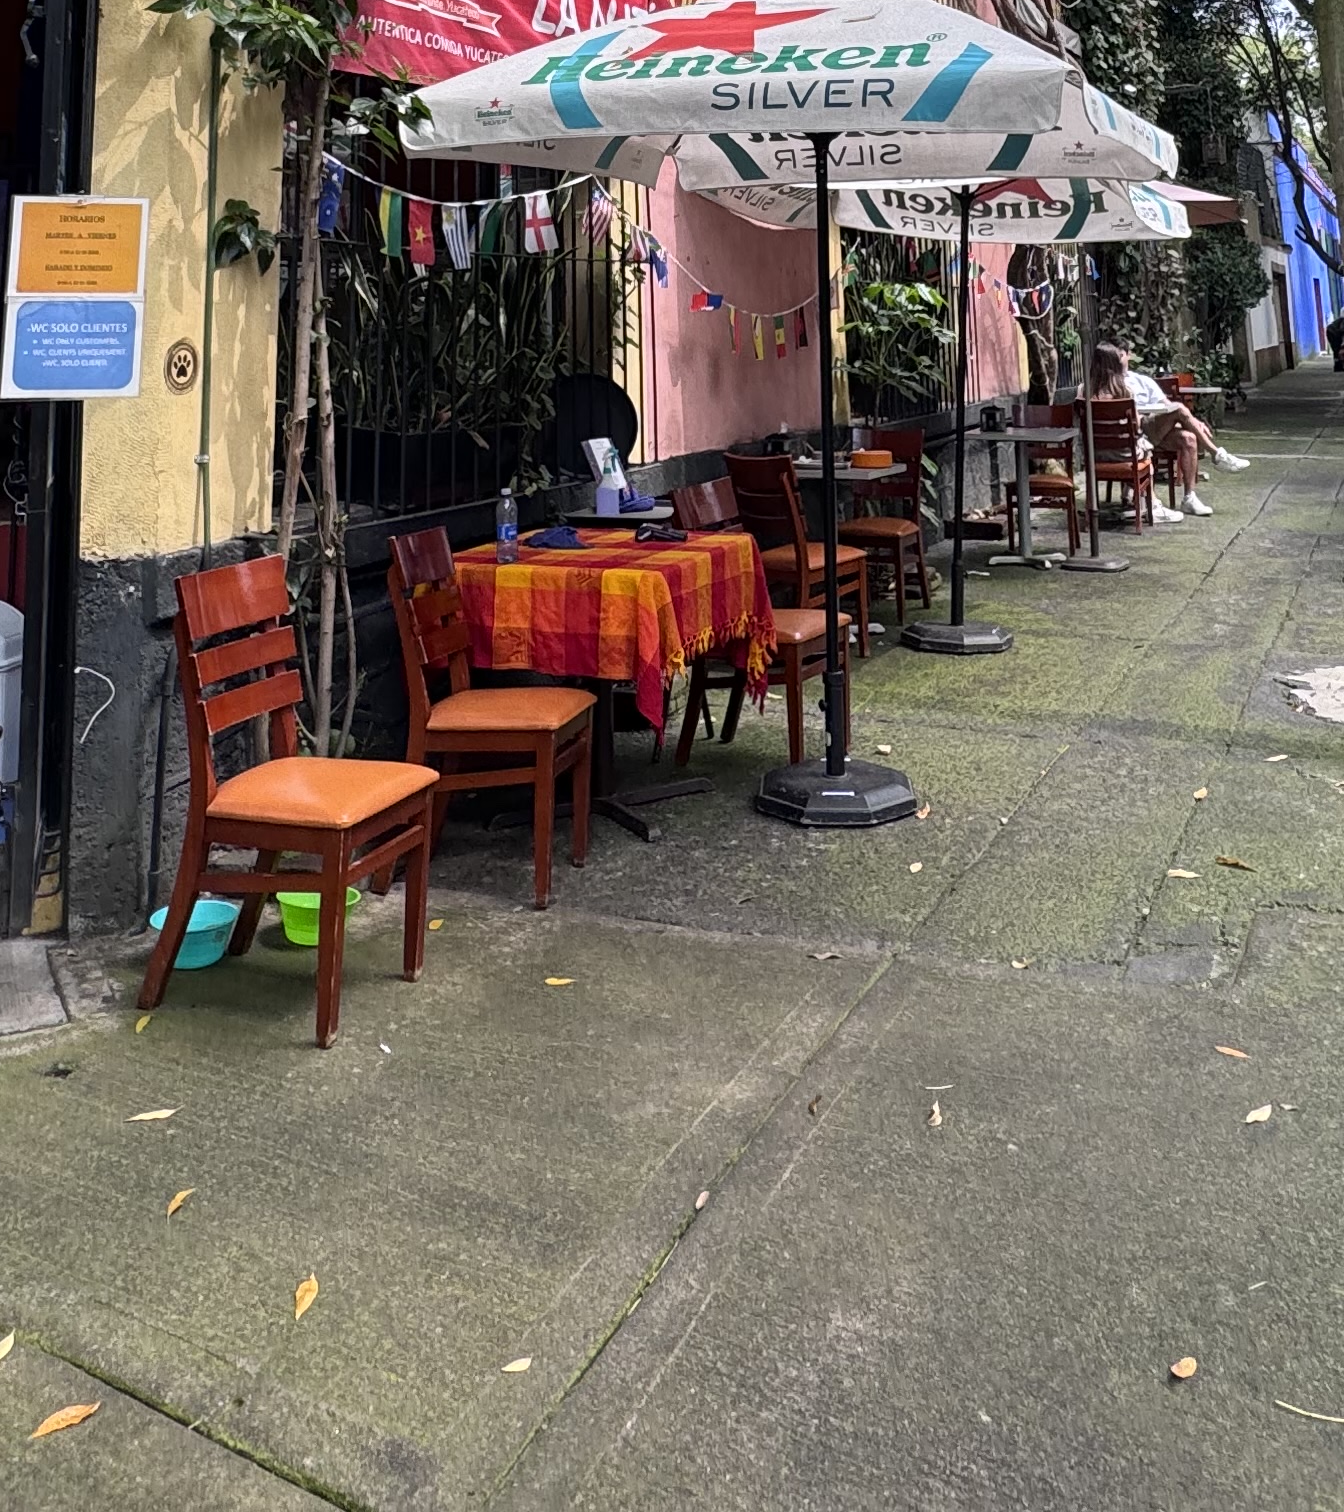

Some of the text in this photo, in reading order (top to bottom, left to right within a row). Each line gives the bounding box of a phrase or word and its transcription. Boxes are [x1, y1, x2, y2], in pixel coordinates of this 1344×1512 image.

[521, 42, 932, 86] Heineken
[711, 78, 895, 111] SILVER
[58, 214, 106, 224] HORARIOS
[30, 322, 128, 334] WC SOLO CLIENTES
